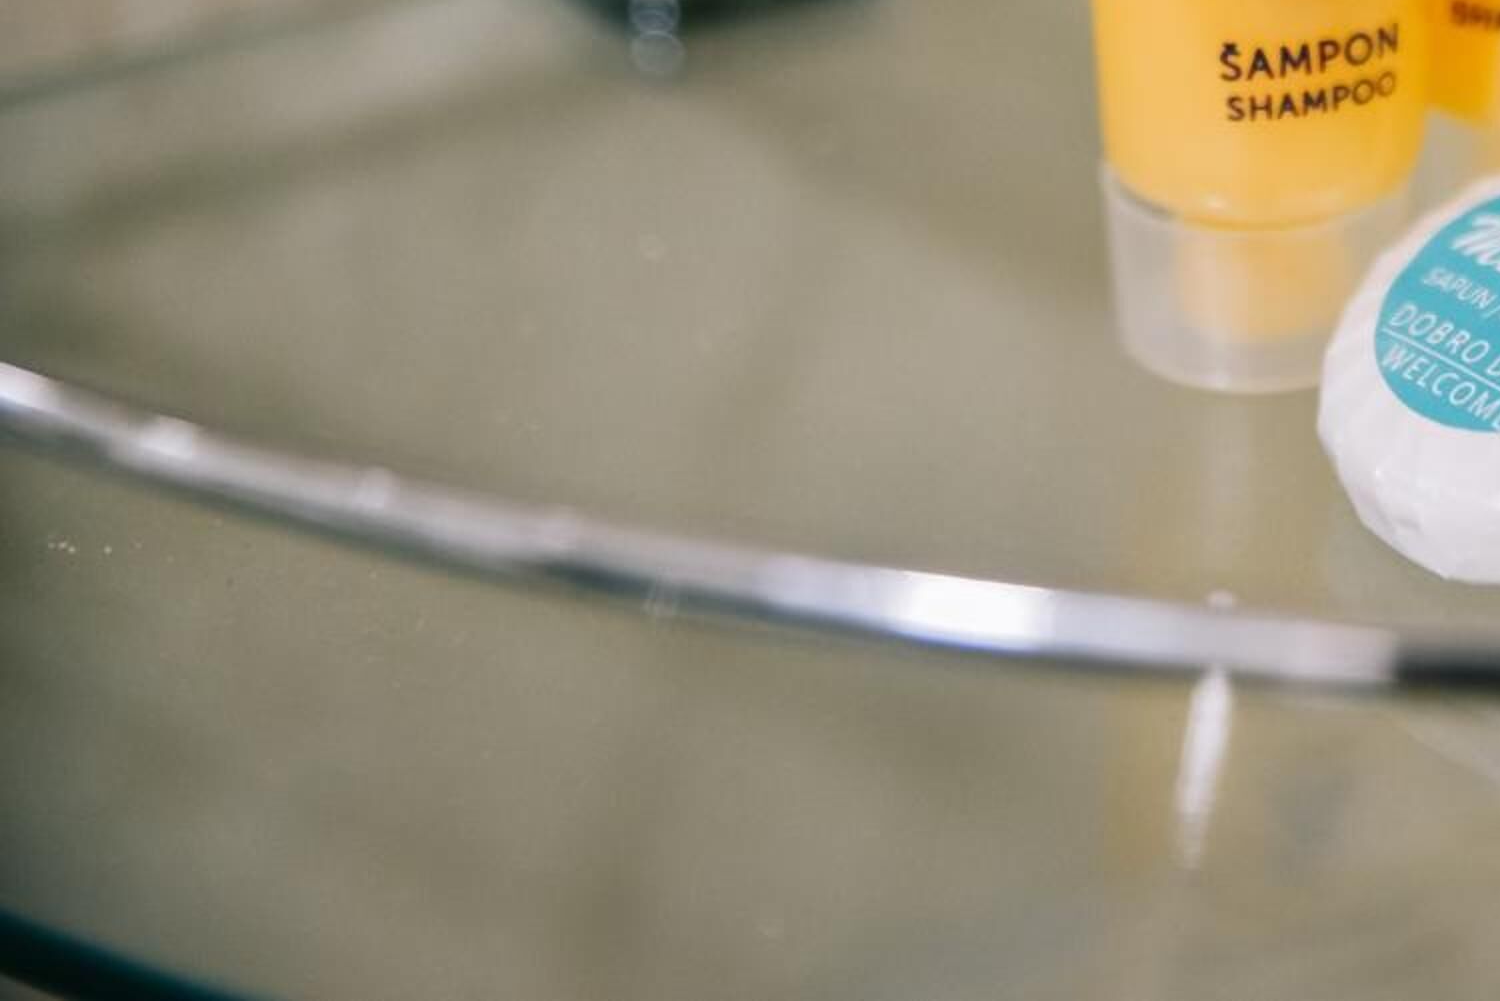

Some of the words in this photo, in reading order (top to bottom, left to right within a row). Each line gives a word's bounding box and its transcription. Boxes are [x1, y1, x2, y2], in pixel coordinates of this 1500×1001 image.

[1219, 23, 1400, 82] ŠAMPON
[1227, 71, 1397, 122] SHAMPOO
[1388, 302, 1490, 365] DOBRO
